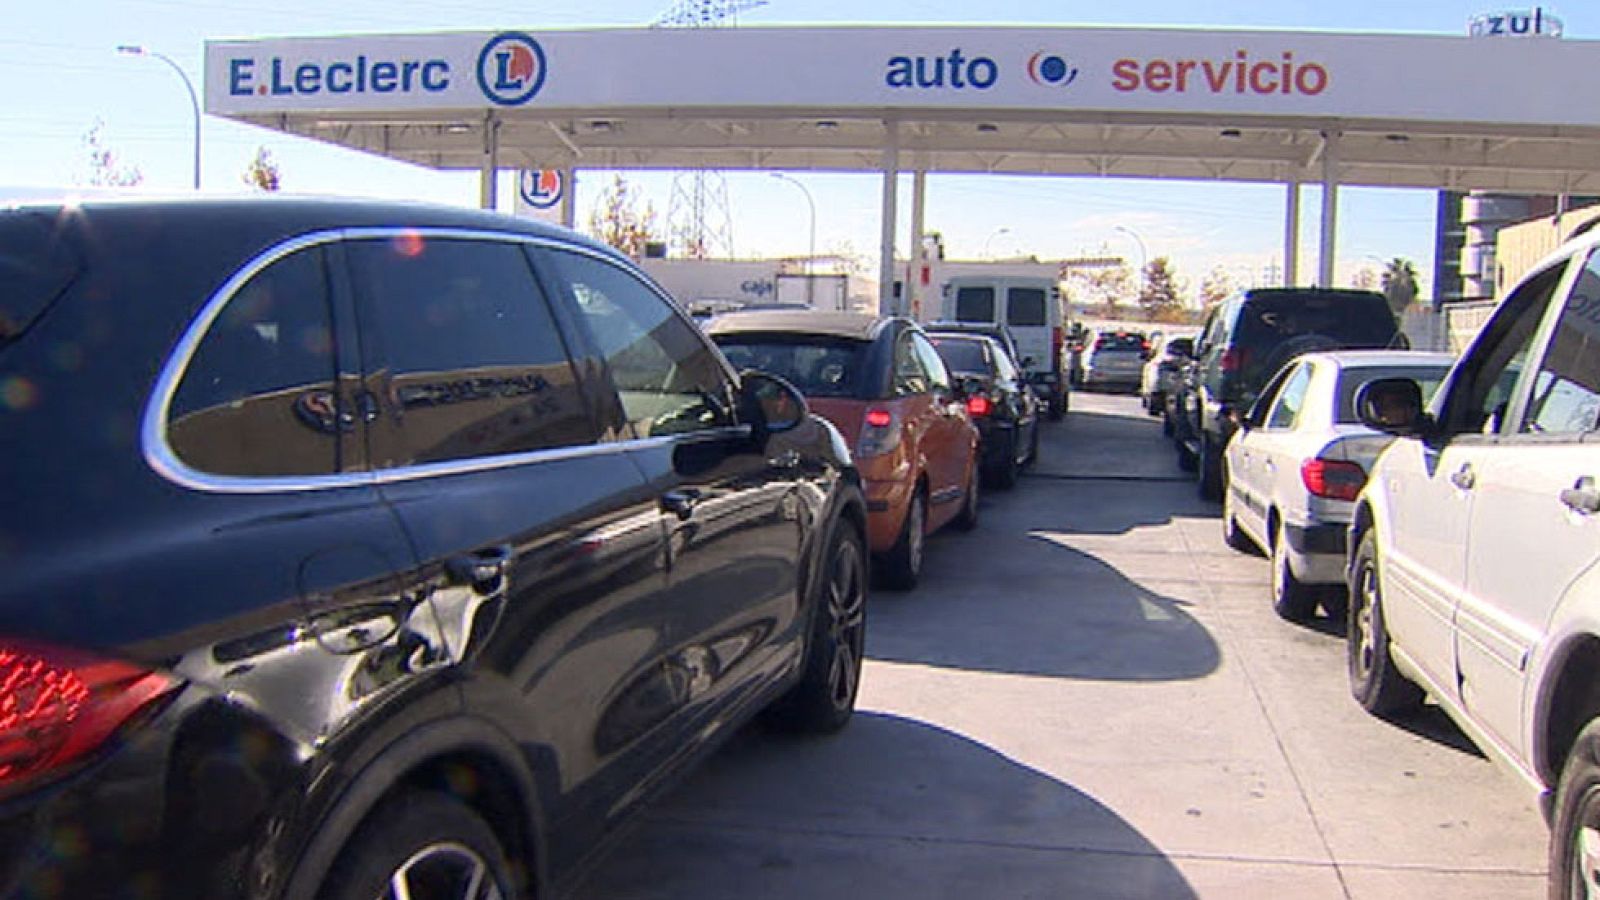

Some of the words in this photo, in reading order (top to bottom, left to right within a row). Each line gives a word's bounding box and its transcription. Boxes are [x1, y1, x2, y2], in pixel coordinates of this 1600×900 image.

[229, 55, 450, 96] E.Leclerc
[885, 48, 998, 90] auto
[1112, 50, 1328, 95] servicio
